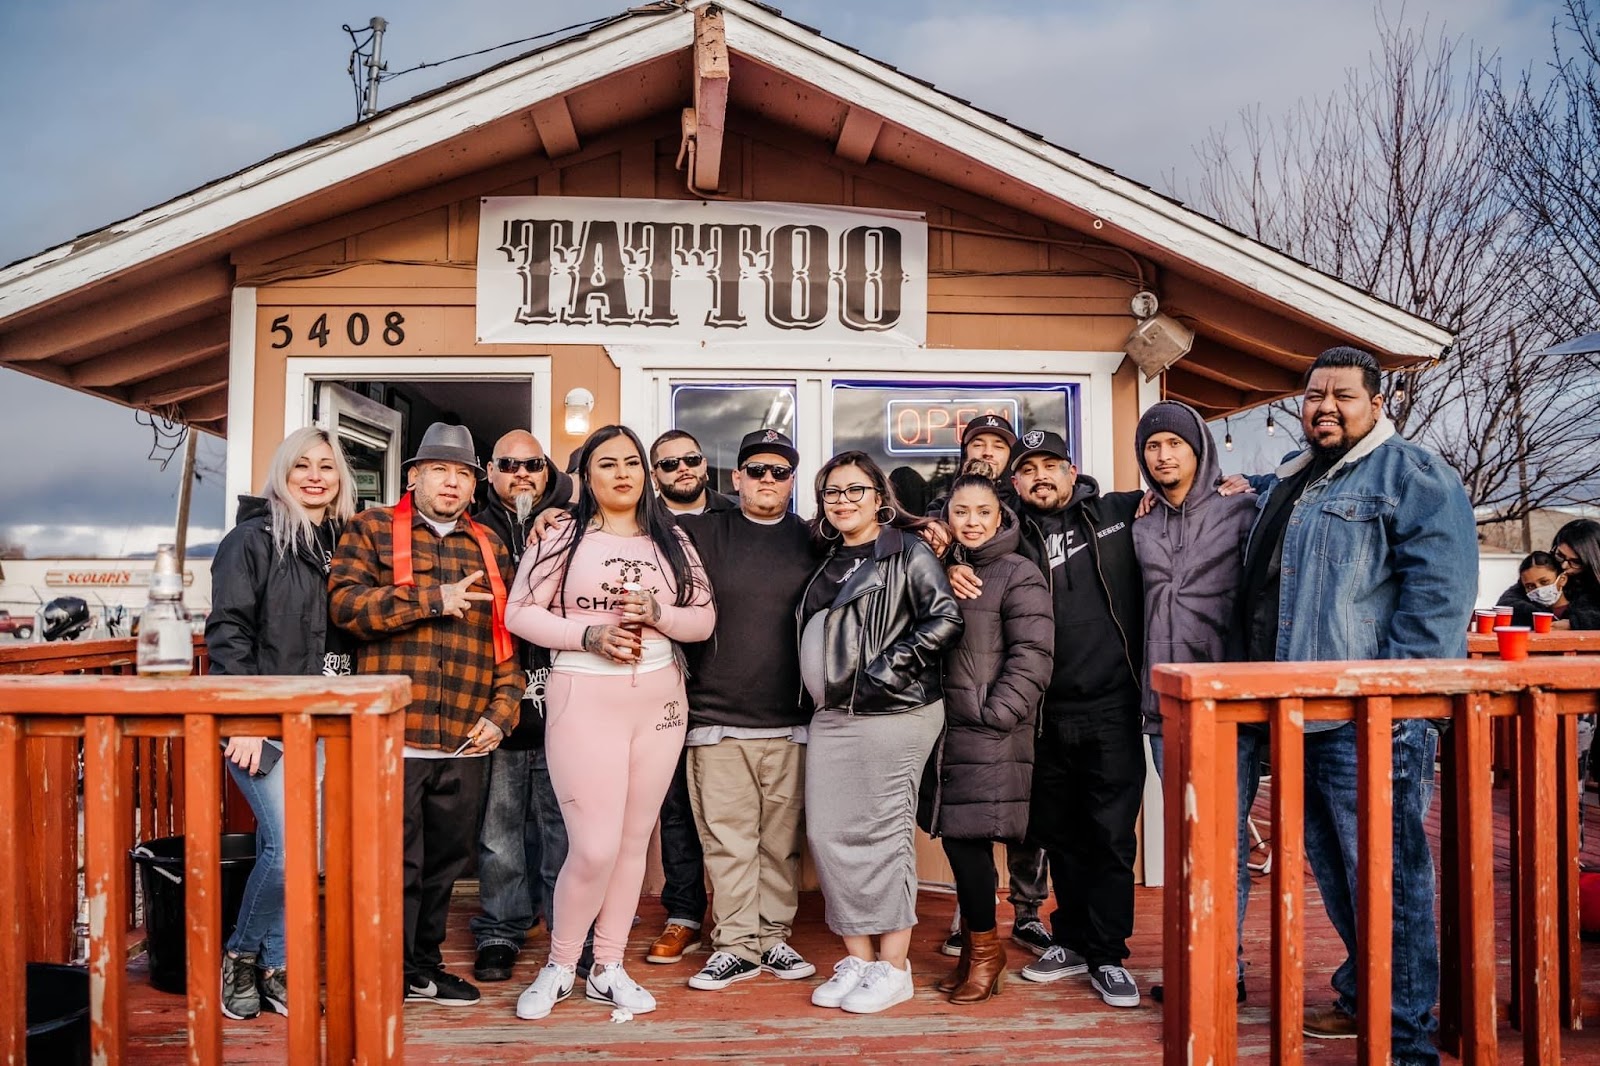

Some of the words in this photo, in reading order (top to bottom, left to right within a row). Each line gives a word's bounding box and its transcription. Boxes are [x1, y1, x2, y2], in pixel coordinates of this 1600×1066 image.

[497, 219, 905, 332] TATTOO
[271, 311, 405, 349] 5408
[898, 408, 1008, 445] OPE
